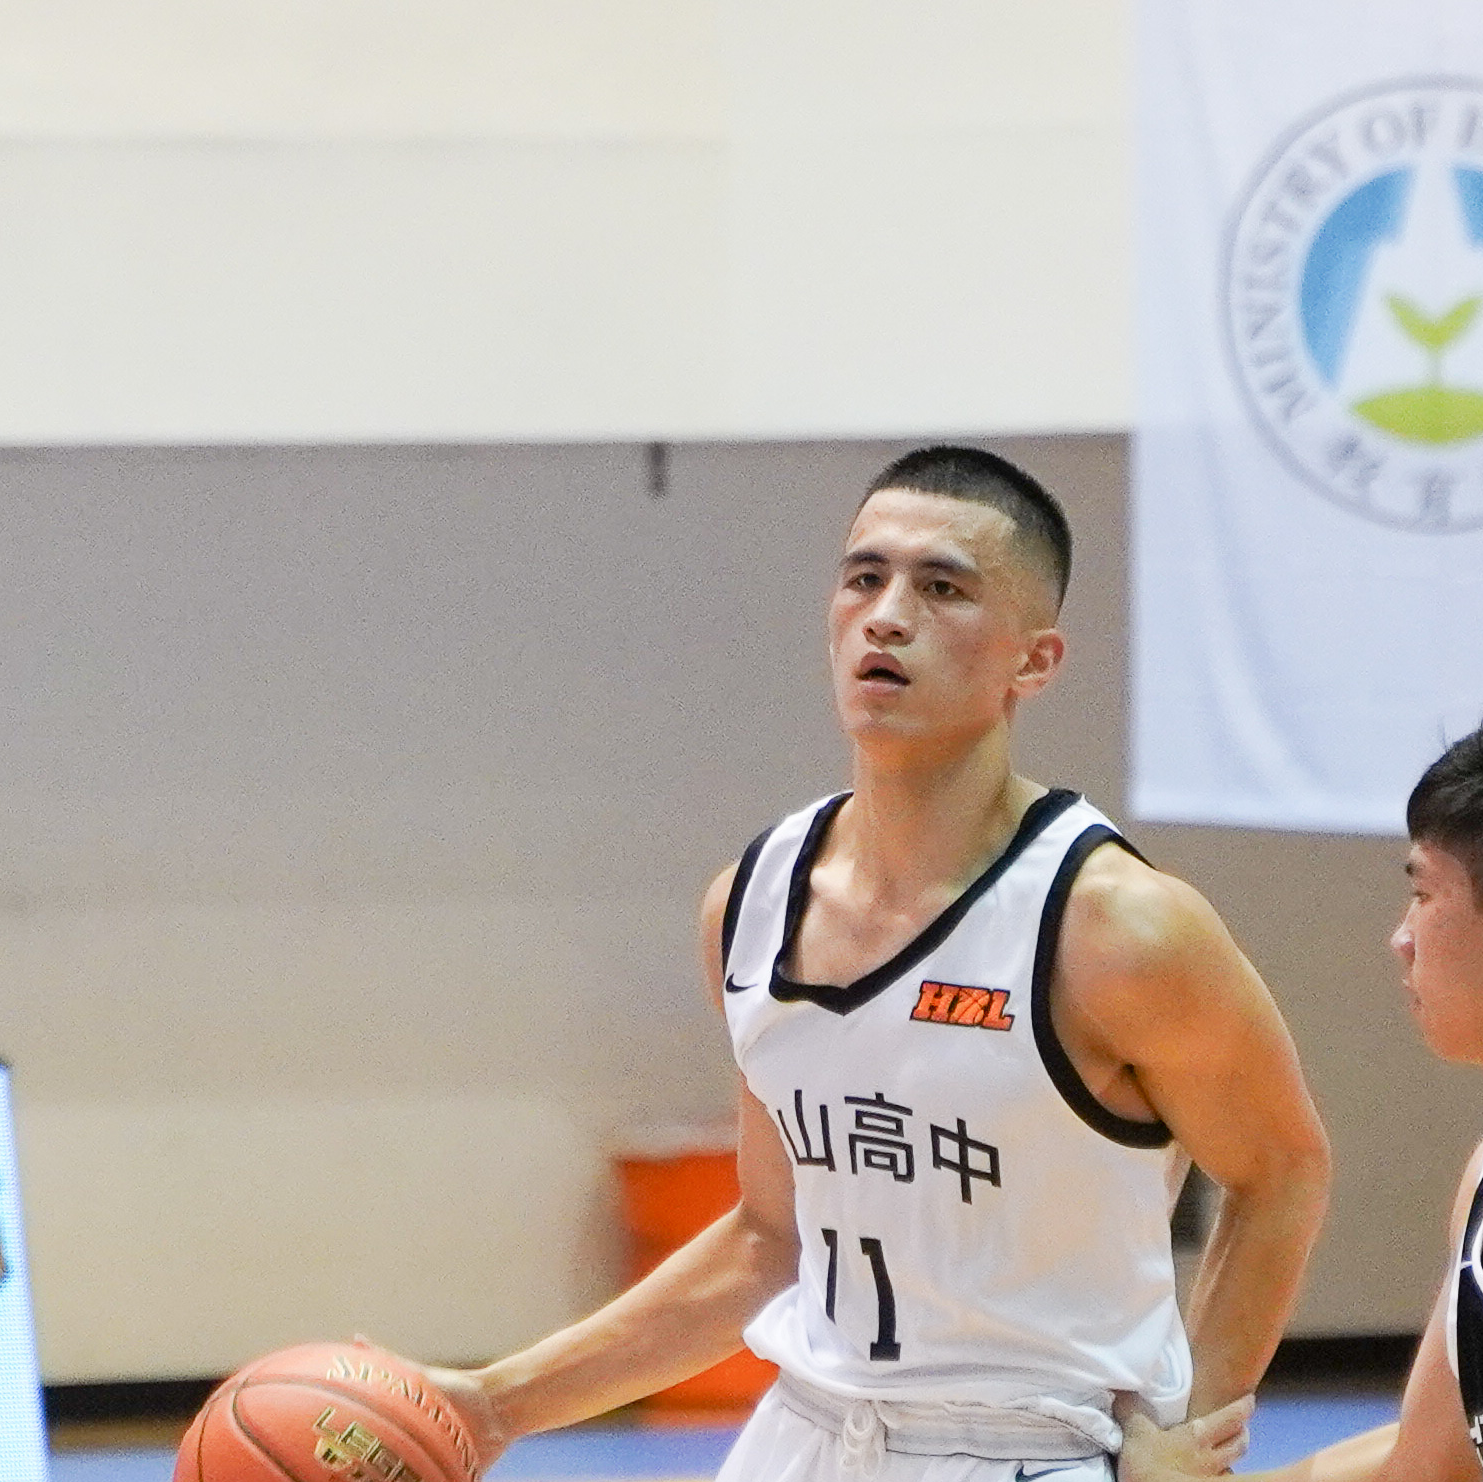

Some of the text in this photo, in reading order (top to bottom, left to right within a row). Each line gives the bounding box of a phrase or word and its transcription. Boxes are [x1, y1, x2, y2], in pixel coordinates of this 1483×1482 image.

[1242, 133, 1350, 426] MINISTRY
[1359, 104, 1440, 152] OF
[909, 980, 1015, 1031] HBL
[821, 1227, 902, 1362] 11
